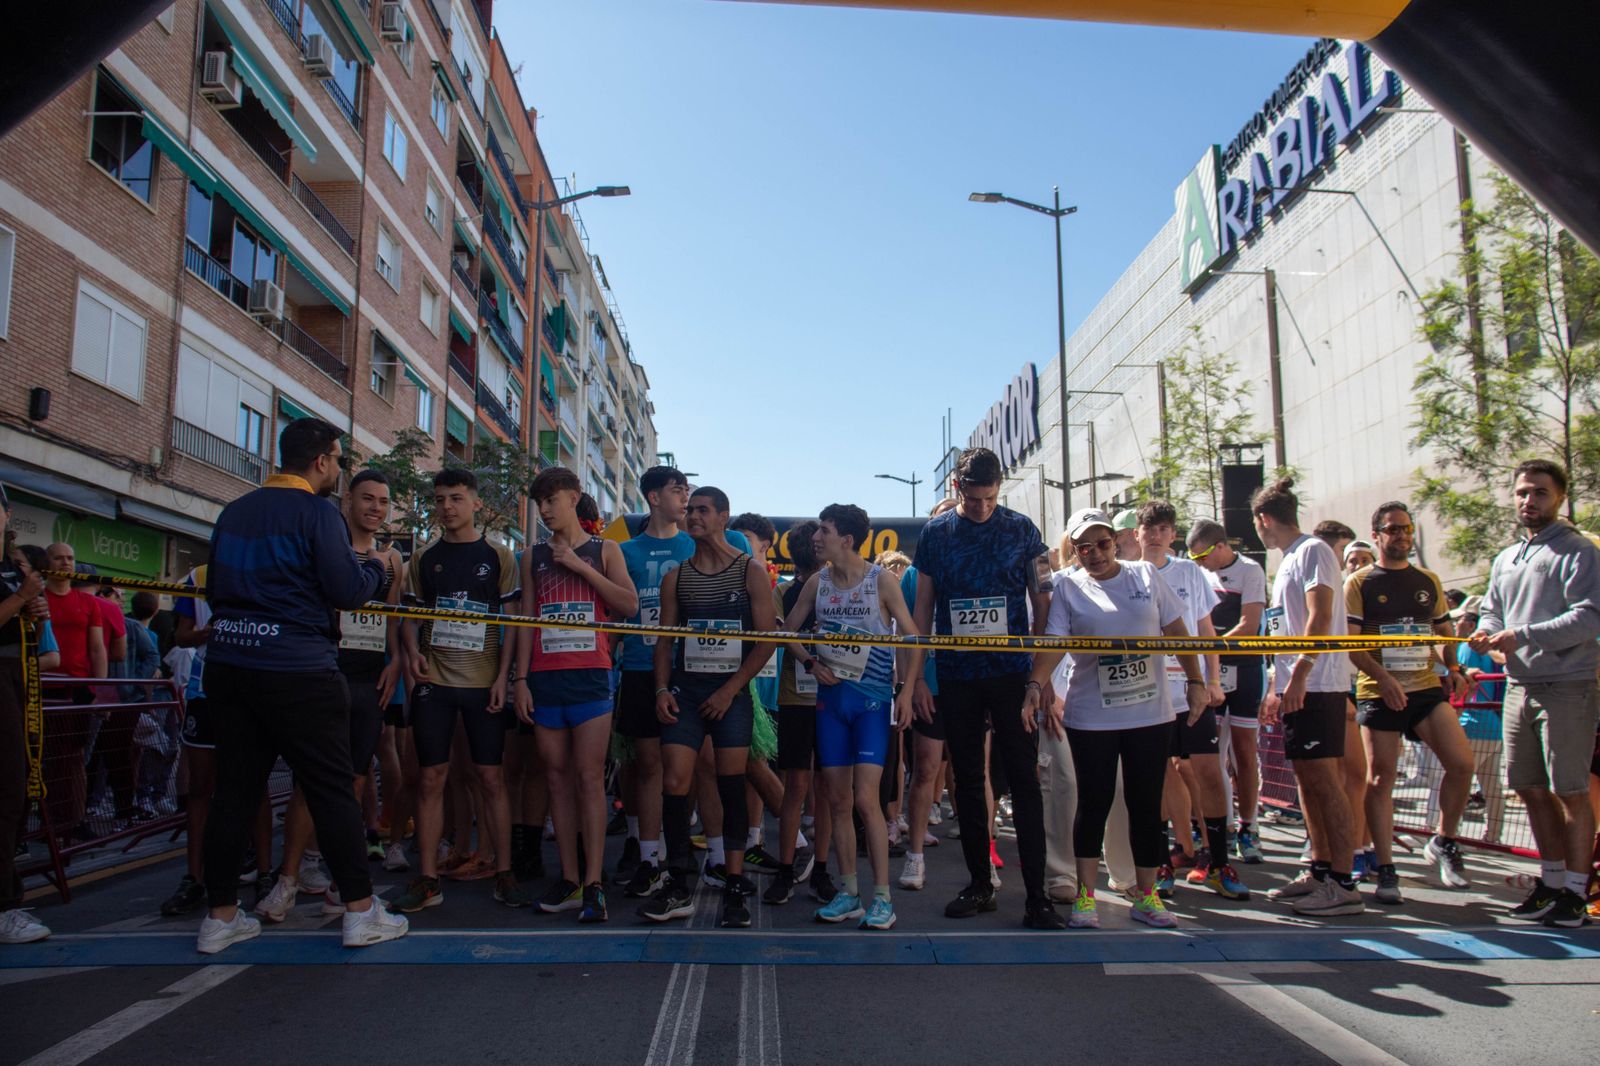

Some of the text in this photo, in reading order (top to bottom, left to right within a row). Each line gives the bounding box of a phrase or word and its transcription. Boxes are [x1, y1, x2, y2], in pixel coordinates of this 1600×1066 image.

[1179, 42, 1393, 287] ARABIAL
[91, 527, 140, 562] Vennde
[350, 611, 382, 626] 1613
[823, 607, 871, 617] MARACENA
[958, 608, 999, 625] 2270
[213, 617, 280, 636] agustinos
[824, 632, 904, 642] MARCELINO
[929, 636, 1009, 646] MARCELINO
[1033, 639, 1113, 648] MARCELINO
[1136, 640, 1215, 649] MARCELINO
[1108, 660, 1147, 681] 2530
[27, 655, 39, 736] MARCELINO
